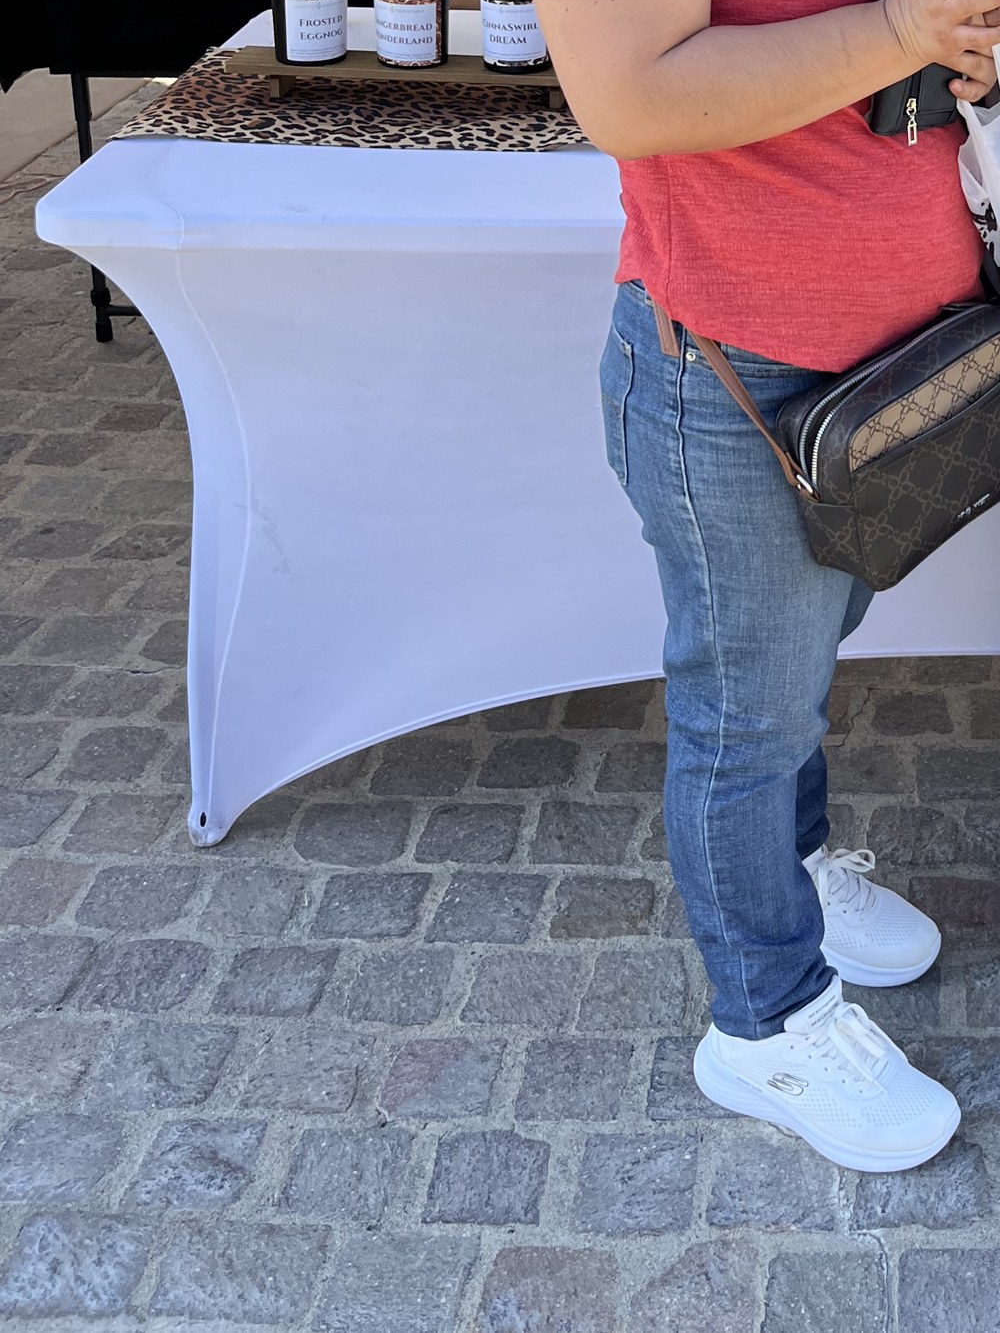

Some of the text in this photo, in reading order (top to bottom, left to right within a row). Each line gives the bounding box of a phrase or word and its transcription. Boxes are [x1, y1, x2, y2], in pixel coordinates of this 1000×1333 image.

[300, 15, 342, 26] FROSTED
[300, 28, 342, 40] EGGNOG
[490, 34, 526, 44] DREAM
